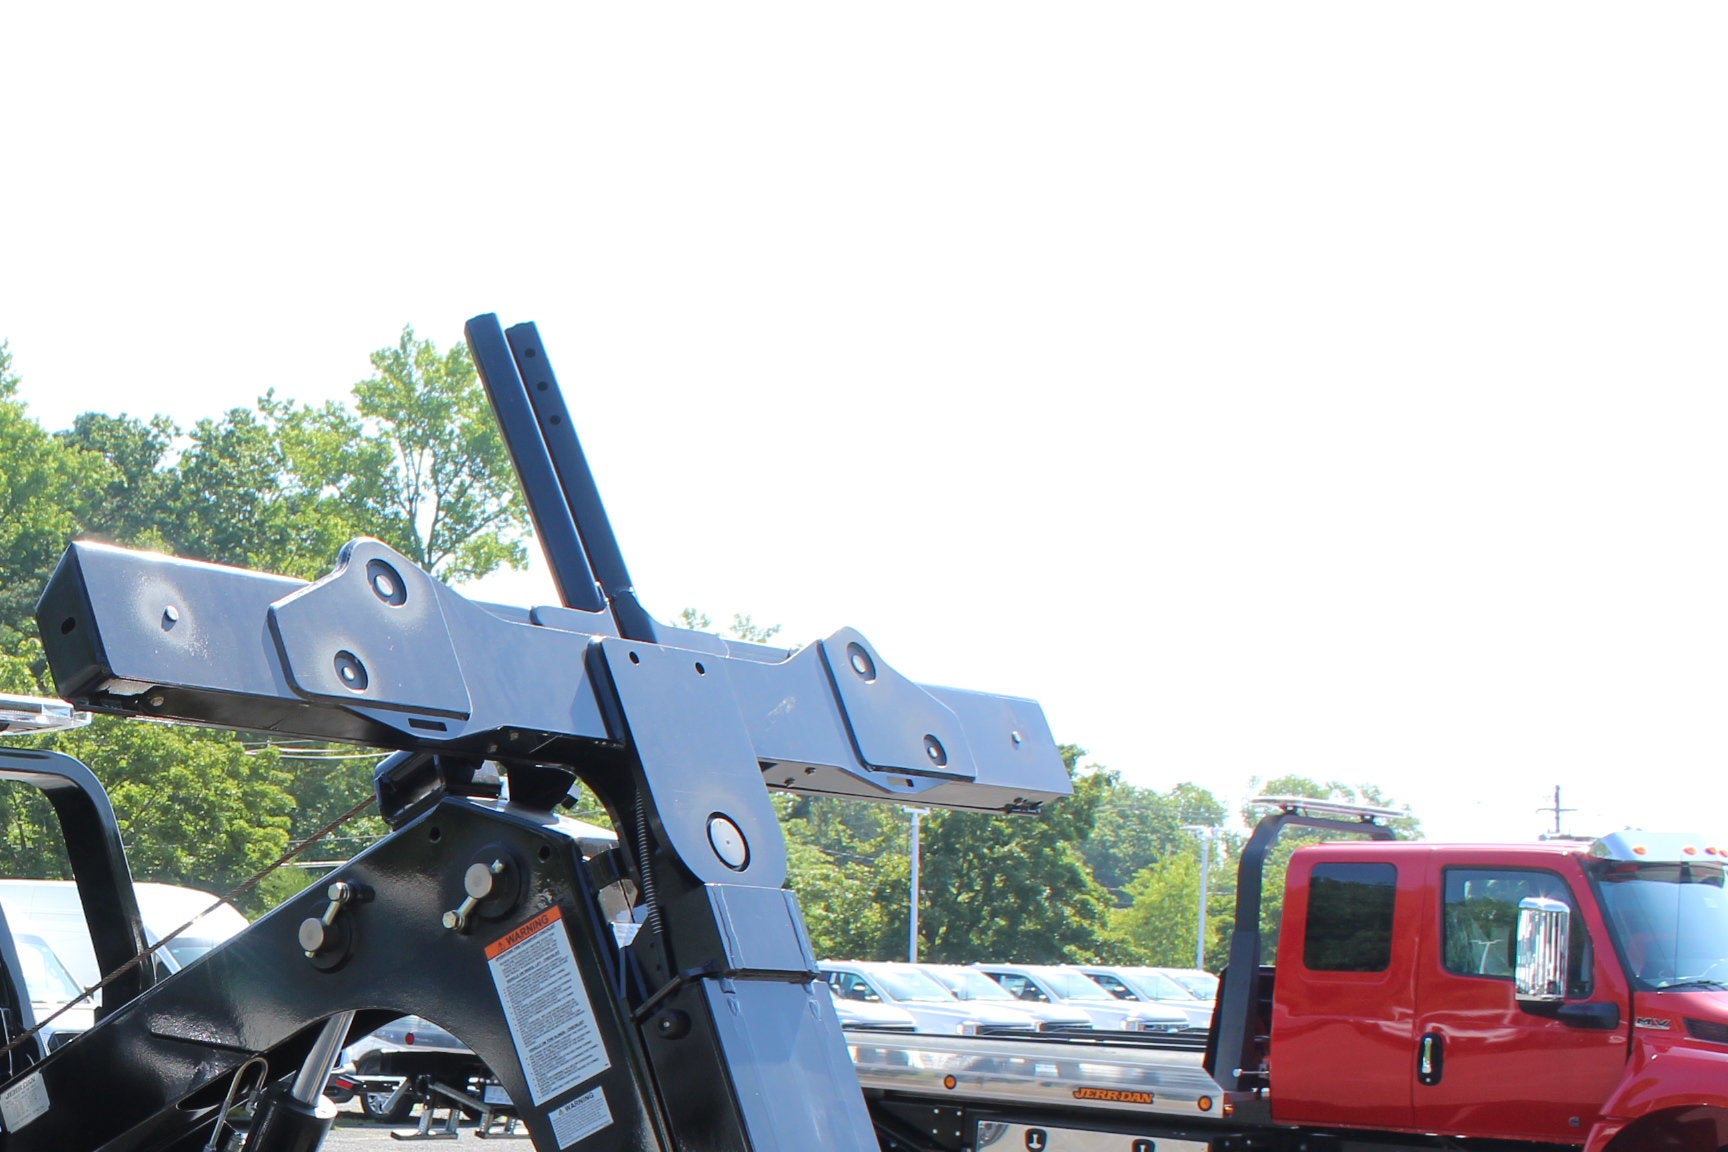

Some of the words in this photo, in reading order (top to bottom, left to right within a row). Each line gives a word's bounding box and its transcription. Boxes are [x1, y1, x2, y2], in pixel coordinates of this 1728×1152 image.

[506, 914, 549, 946] WARNING
[1635, 1017, 1671, 1029] MV
[564, 1092, 595, 1112] WARNING
